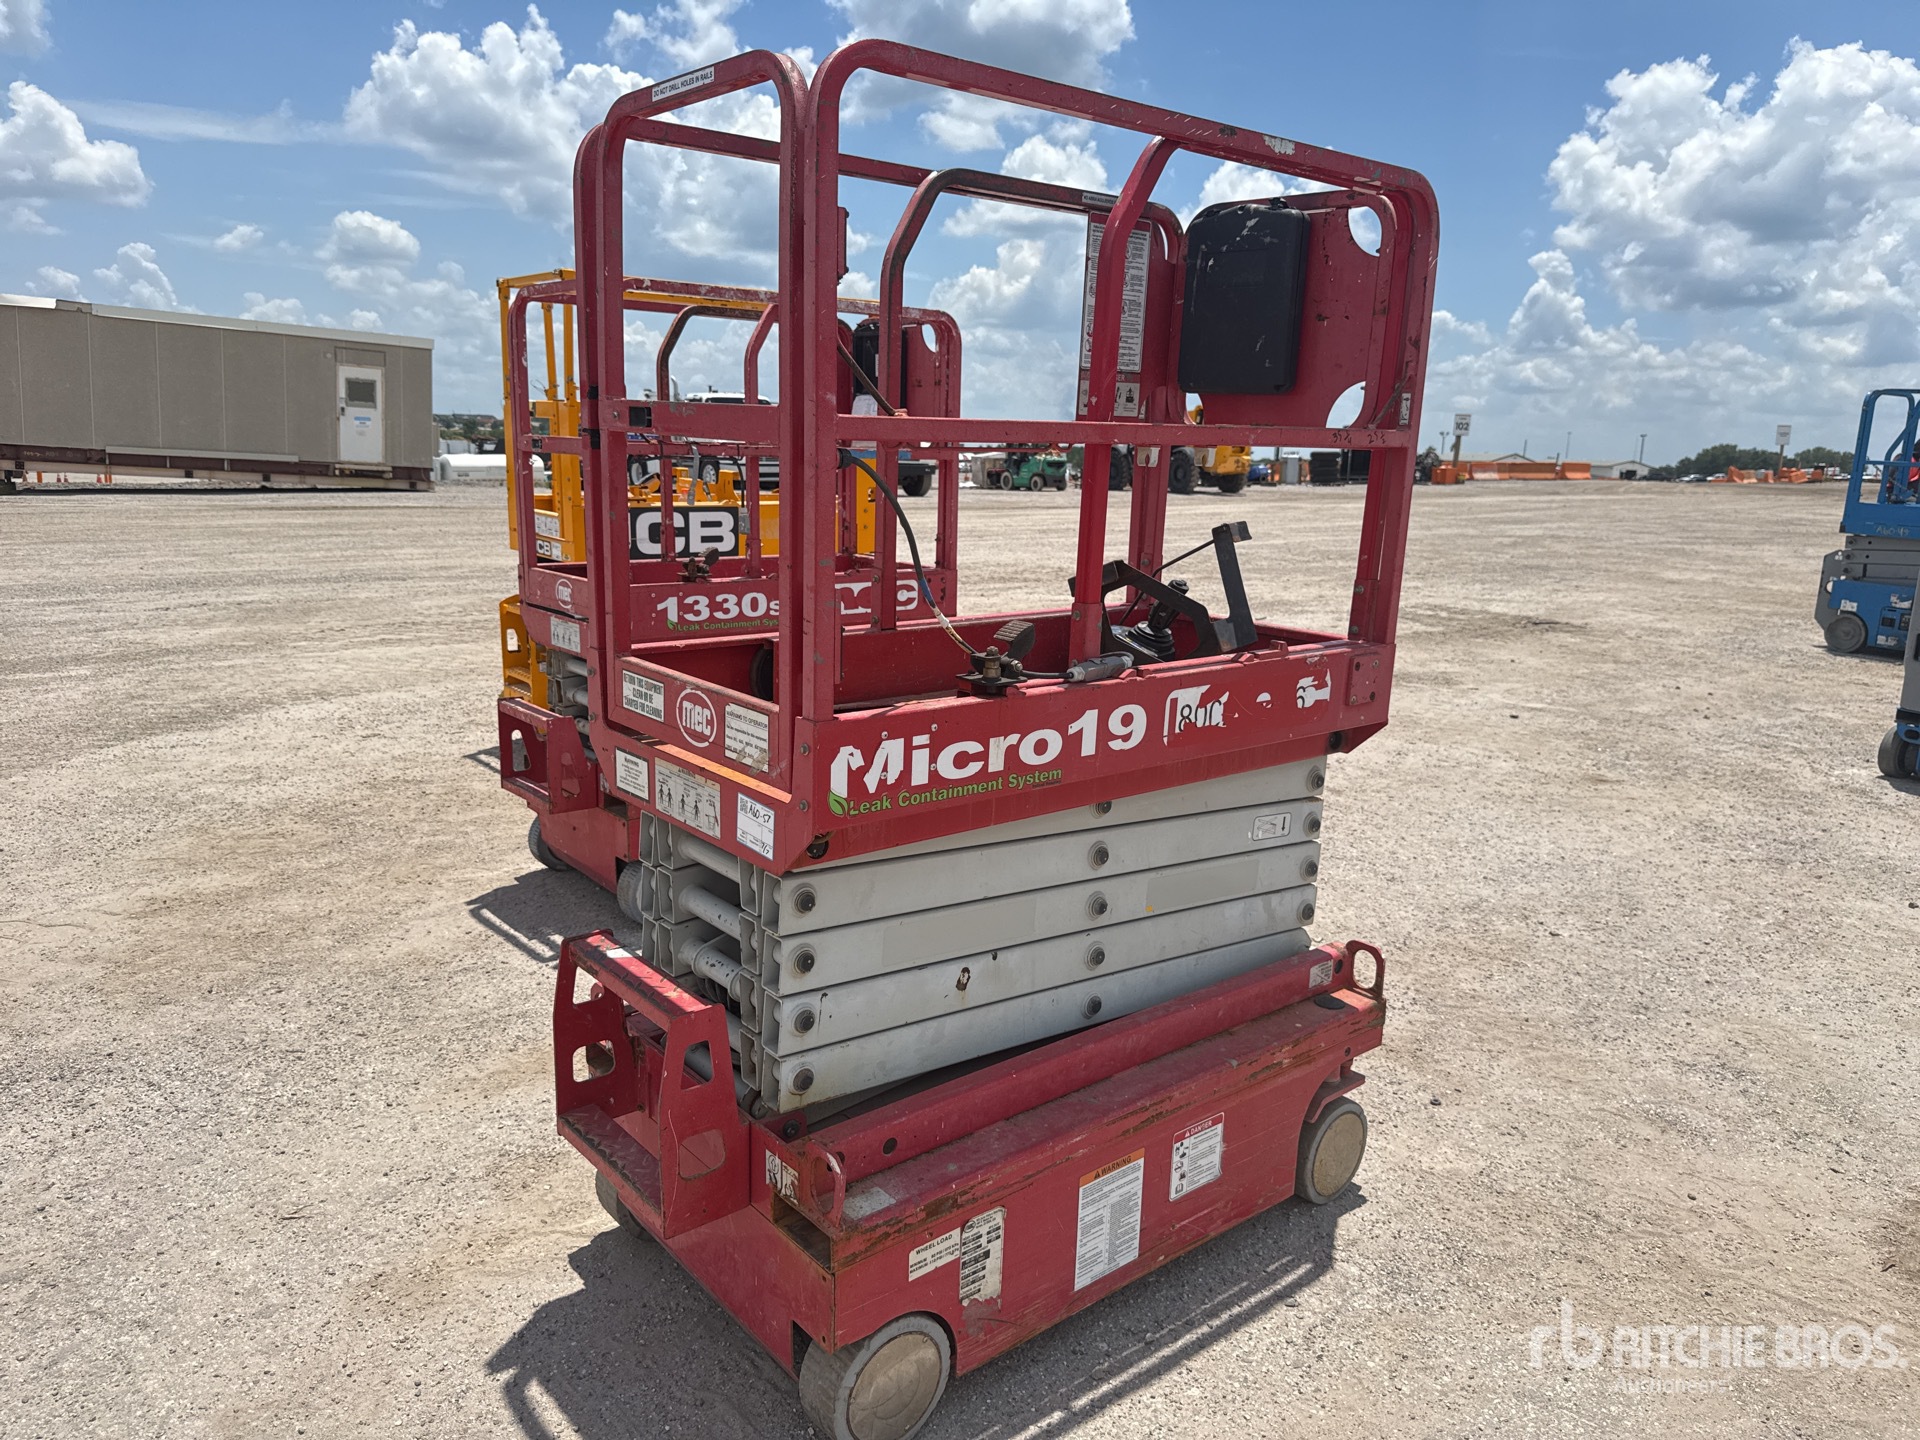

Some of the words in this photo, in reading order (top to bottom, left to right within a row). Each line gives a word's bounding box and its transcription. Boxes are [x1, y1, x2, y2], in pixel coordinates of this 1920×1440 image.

[653, 90, 659, 98] DO
[660, 86, 668, 96] NOT
[669, 83, 680, 93] DRILL
[681, 78, 694, 89] HOLES
[695, 75, 700, 83] IN
[700, 71, 713, 81] RAILS
[1455, 421, 1469, 431] 102
[633, 510, 737, 555] CB
[536, 540, 551, 556] CB
[677, 624, 700, 632] Leak
[703, 618, 761, 630] Containment
[850, 792, 892, 816] Leak
[898, 777, 1004, 808] Containment
[1008, 768, 1063, 791] System
[1190, 1120, 1213, 1135] DANGER
[1101, 1156, 1132, 1176] WARNING
[916, 1242, 936, 1255] WHEEL
[936, 1234, 953, 1246] LOAD
